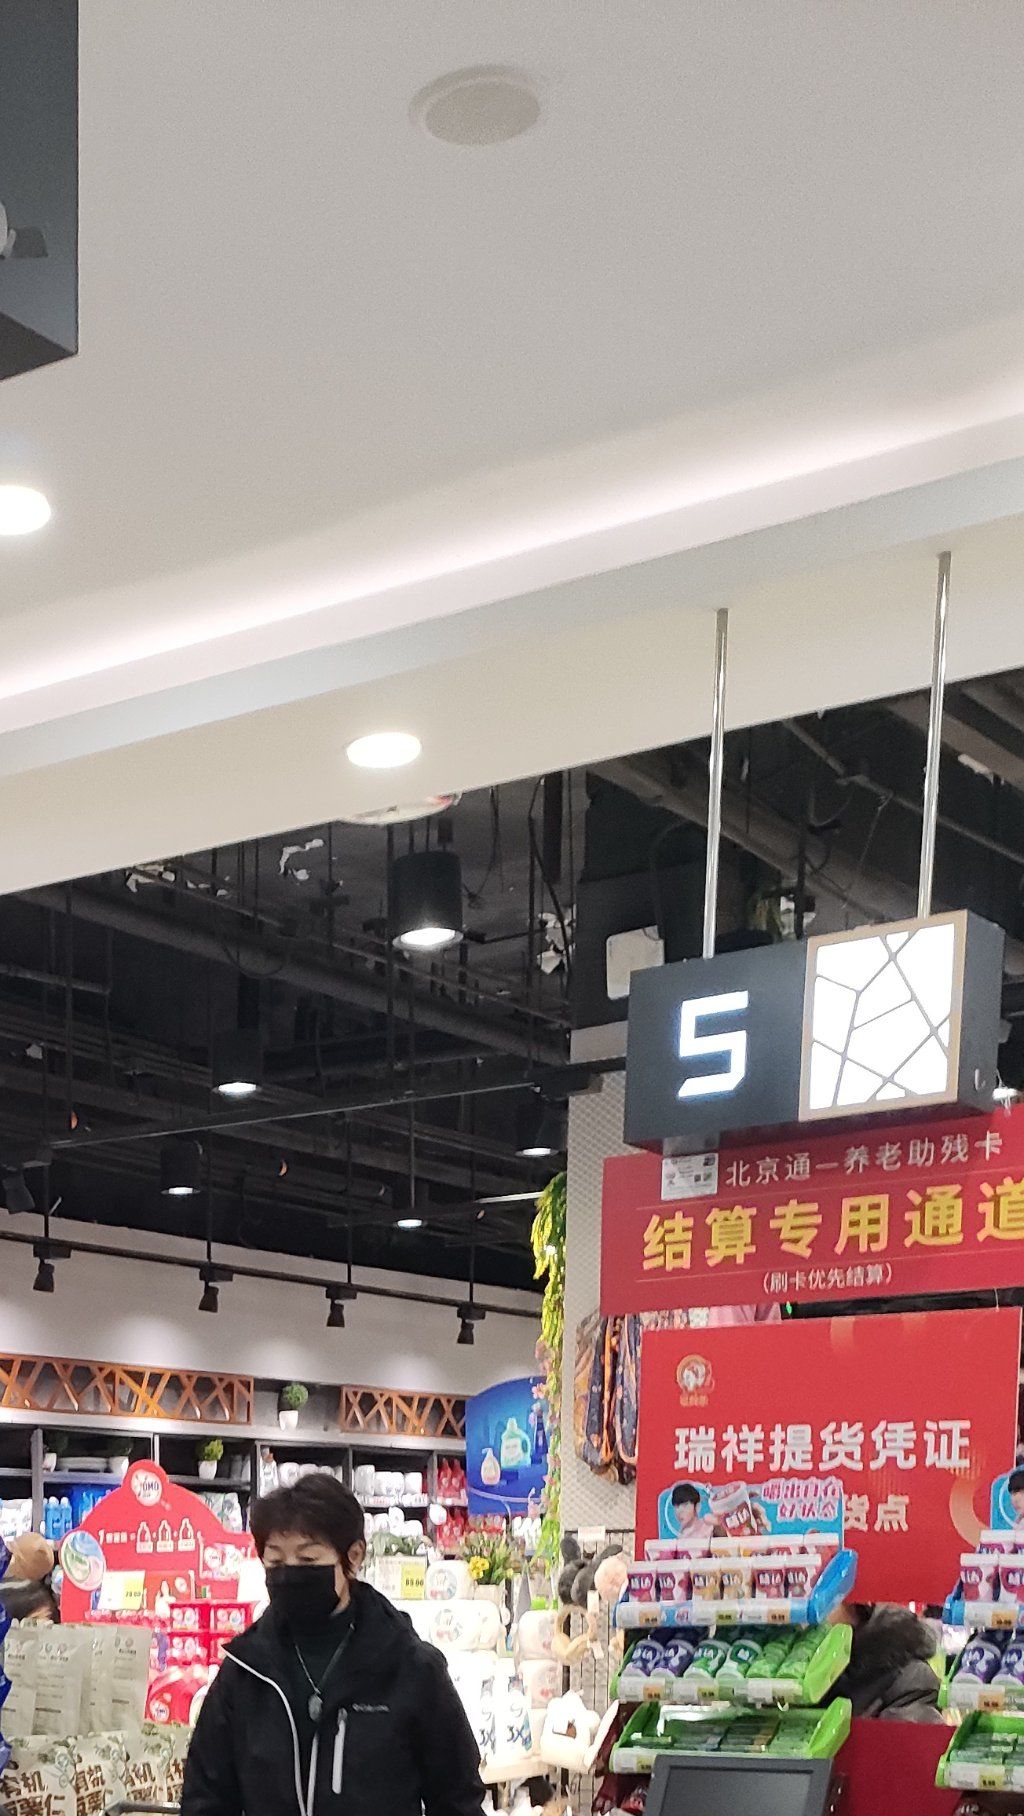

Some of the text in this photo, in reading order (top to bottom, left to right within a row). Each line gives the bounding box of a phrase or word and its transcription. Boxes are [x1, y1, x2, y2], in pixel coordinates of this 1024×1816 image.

[677, 990, 750, 1101] 5
[642, 1176, 1024, 1271] 结算专用通道
[673, 1420, 972, 1473] 瑞祥提货凭证
